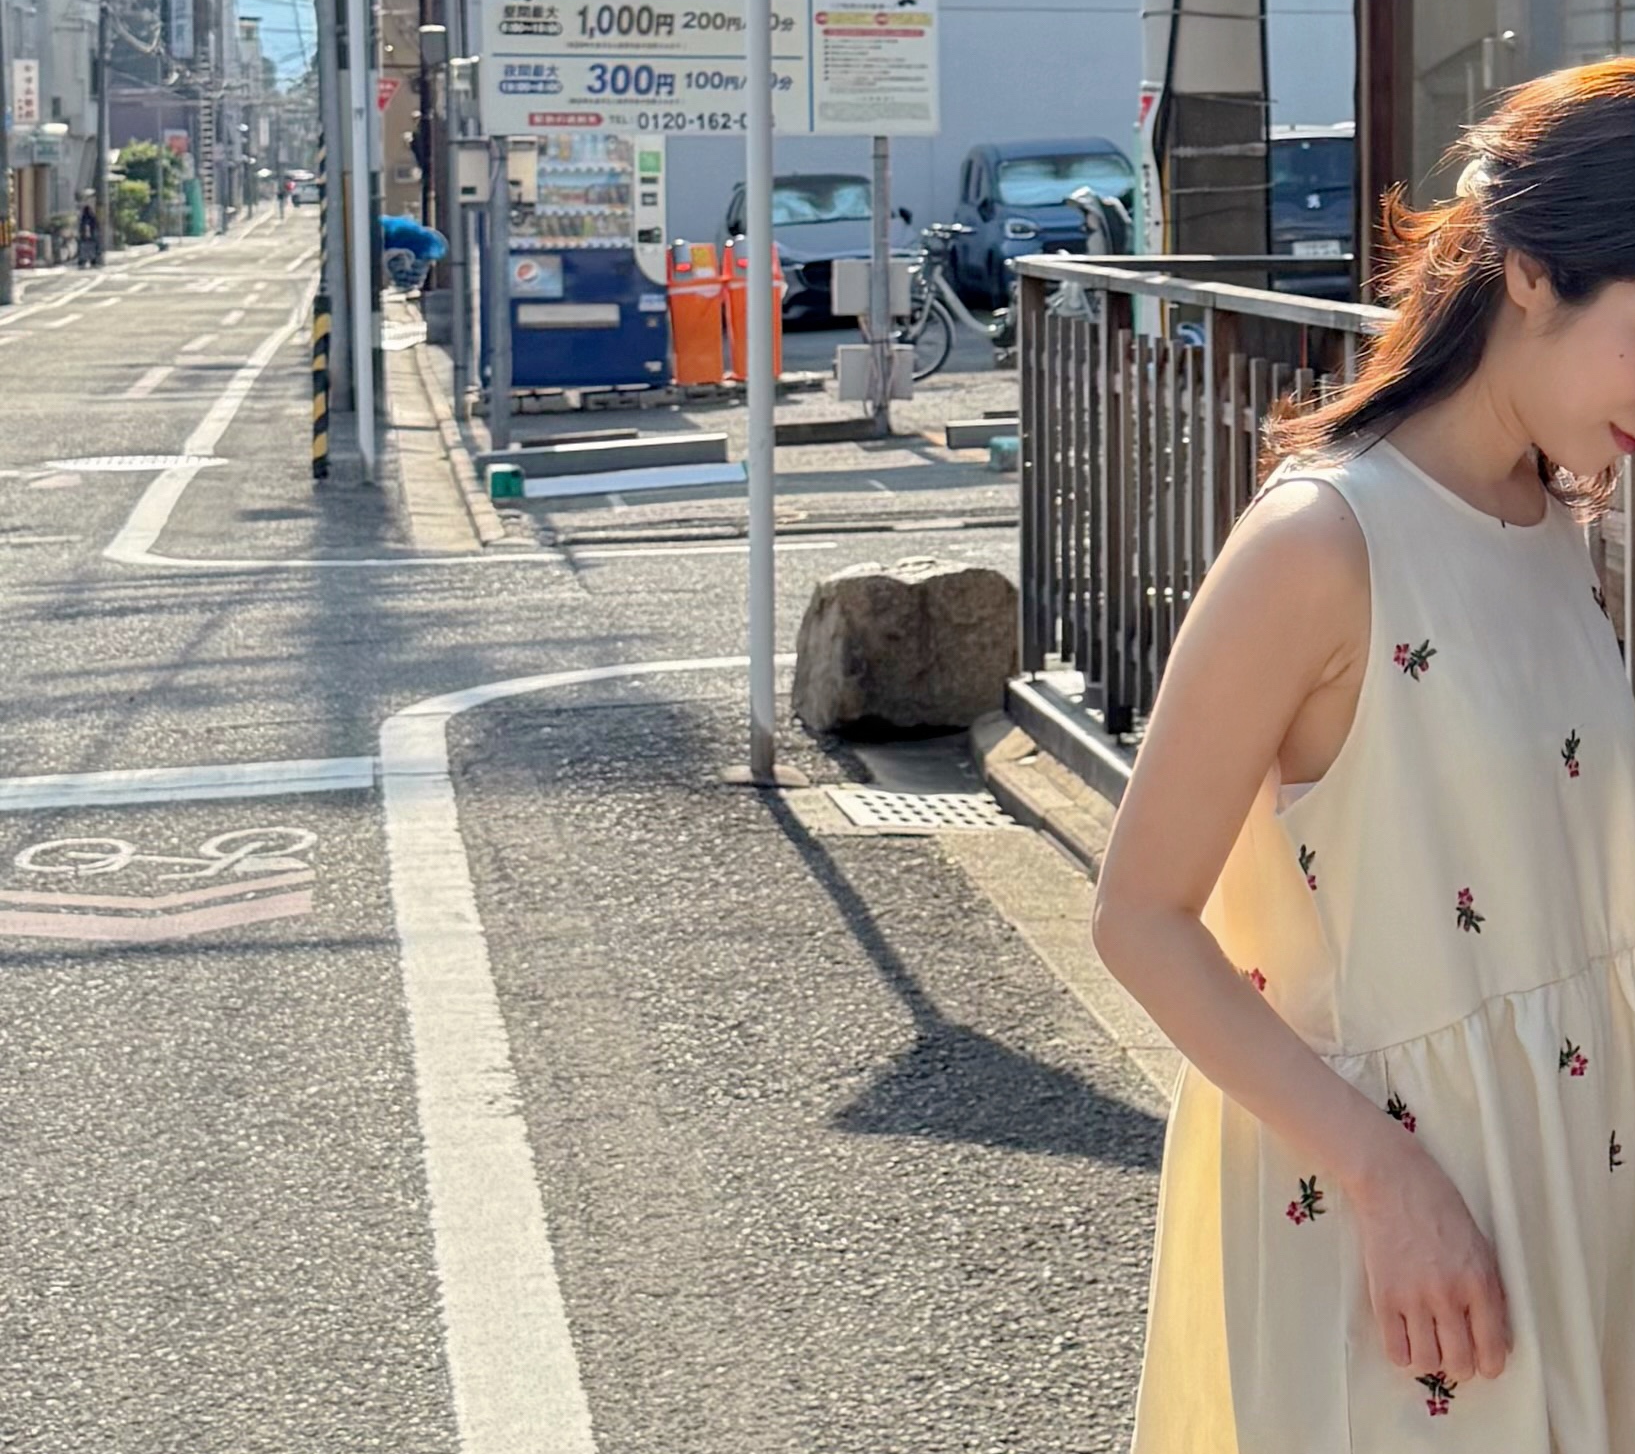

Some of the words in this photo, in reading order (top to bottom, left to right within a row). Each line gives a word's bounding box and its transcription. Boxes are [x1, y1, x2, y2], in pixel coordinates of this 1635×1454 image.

[577, 4, 674, 39] 1,000円
[586, 62, 675, 96] 300円
[638, 112, 776, 130] 0120-162-0
